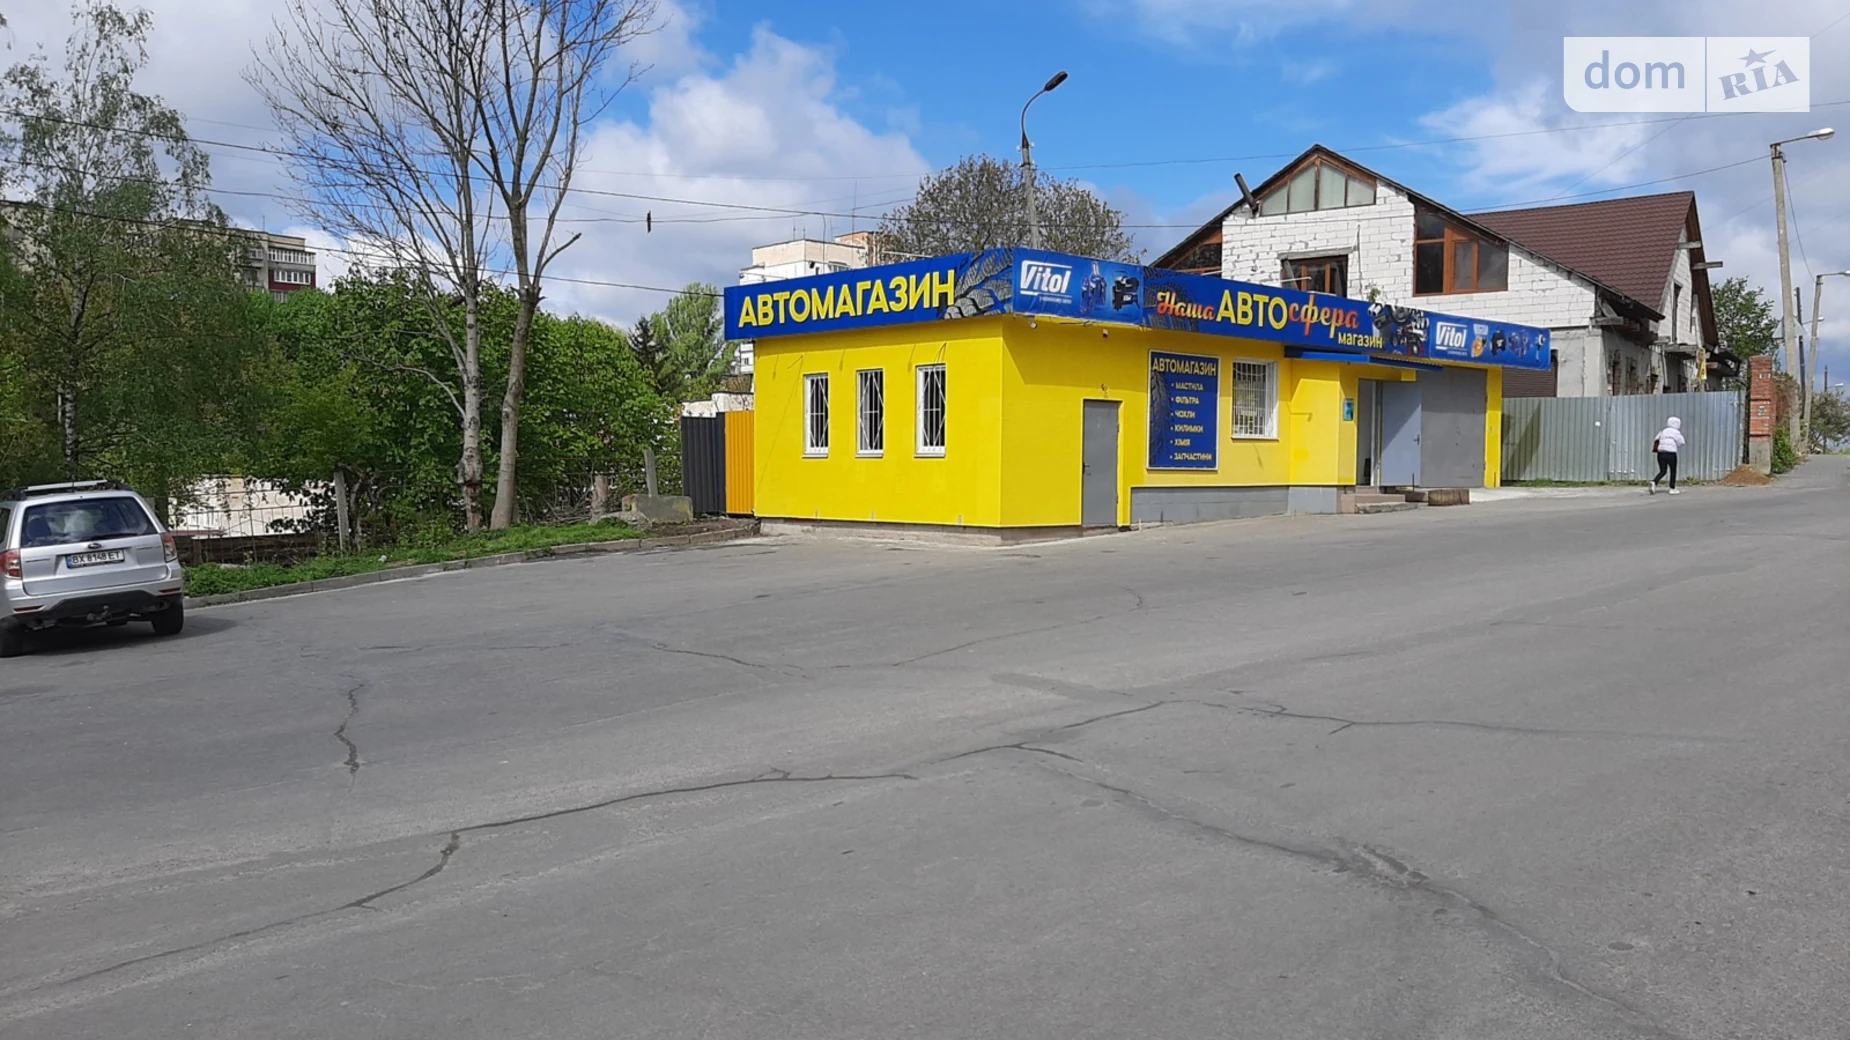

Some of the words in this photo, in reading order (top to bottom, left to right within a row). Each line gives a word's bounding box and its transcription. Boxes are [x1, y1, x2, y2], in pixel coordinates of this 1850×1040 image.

[1020, 261, 1072, 294] Vitol
[738, 269, 956, 328] АВТОМАГАЗИН
[1156, 291, 1215, 321] Наша
[1338, 332, 1384, 350] магазин
[1436, 322, 1468, 348] Vitol
[1152, 357, 1216, 376] АВТОМАГАЗИН
[1175, 382, 1204, 391] МАСТИЛА
[1175, 396, 1200, 405] ФІЛЬТРА
[1173, 452, 1212, 461] ЗАПЧАСТИНИ
[72, 555, 86, 564] BX
